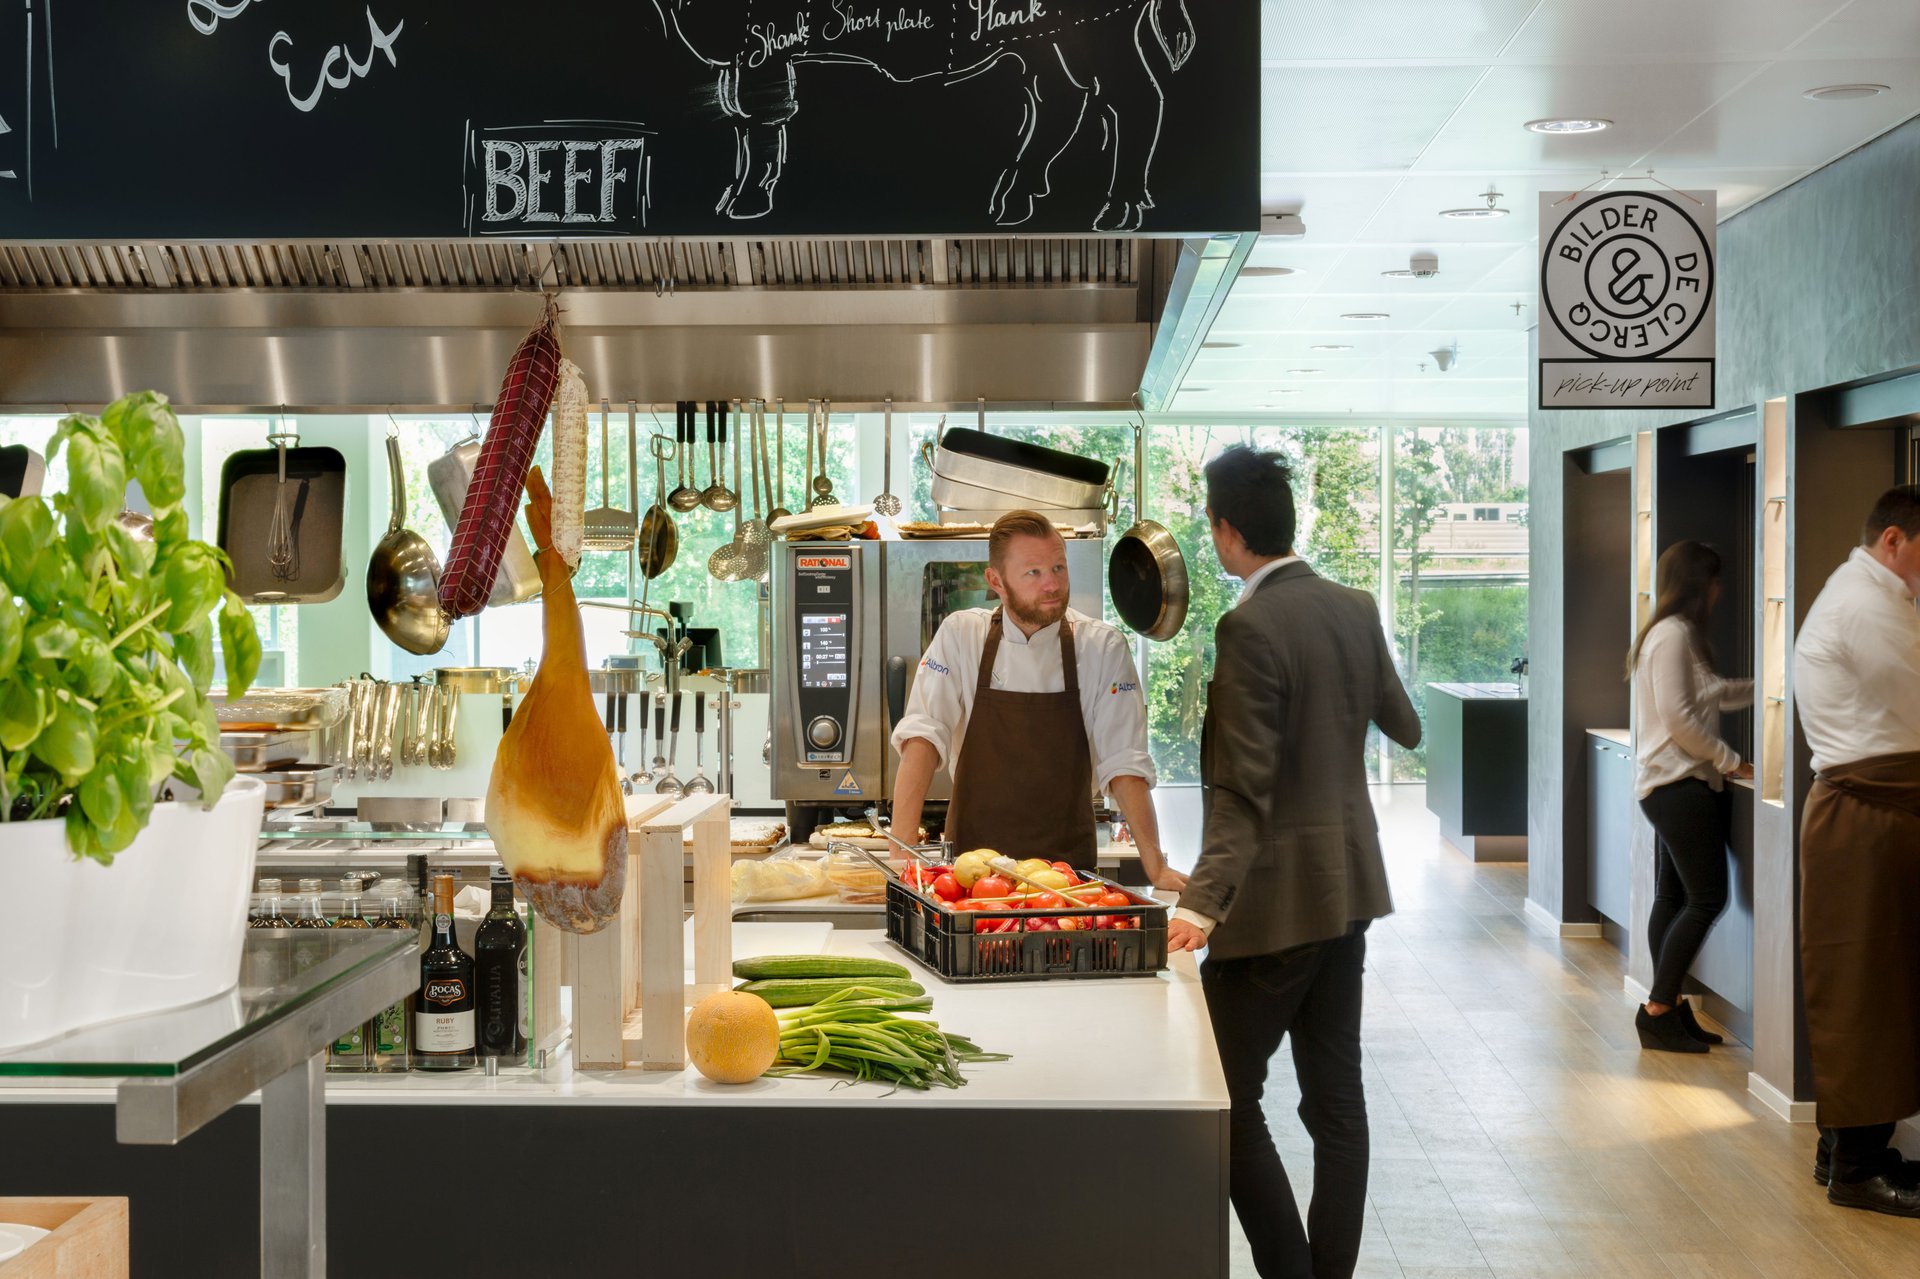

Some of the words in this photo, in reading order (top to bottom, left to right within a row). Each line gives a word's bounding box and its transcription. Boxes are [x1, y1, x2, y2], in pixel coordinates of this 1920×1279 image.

[749, 11, 810, 67] Shank
[823, 0, 880, 41] Short
[886, 8, 934, 42] plate
[269, 4, 404, 112] Eat
[481, 138, 645, 222] BEEF
[1559, 204, 1659, 263] BILDER
[1674, 252, 1700, 293] DE
[1568, 301, 1687, 349] CLERCQ
[1553, 371, 1643, 398] pick-up
[1639, 371, 1700, 398] point
[800, 558, 847, 567] RATIONAL
[925, 658, 949, 675] Albron
[429, 984, 462, 998] POÇAS
[436, 1017, 455, 1025] RUBY
